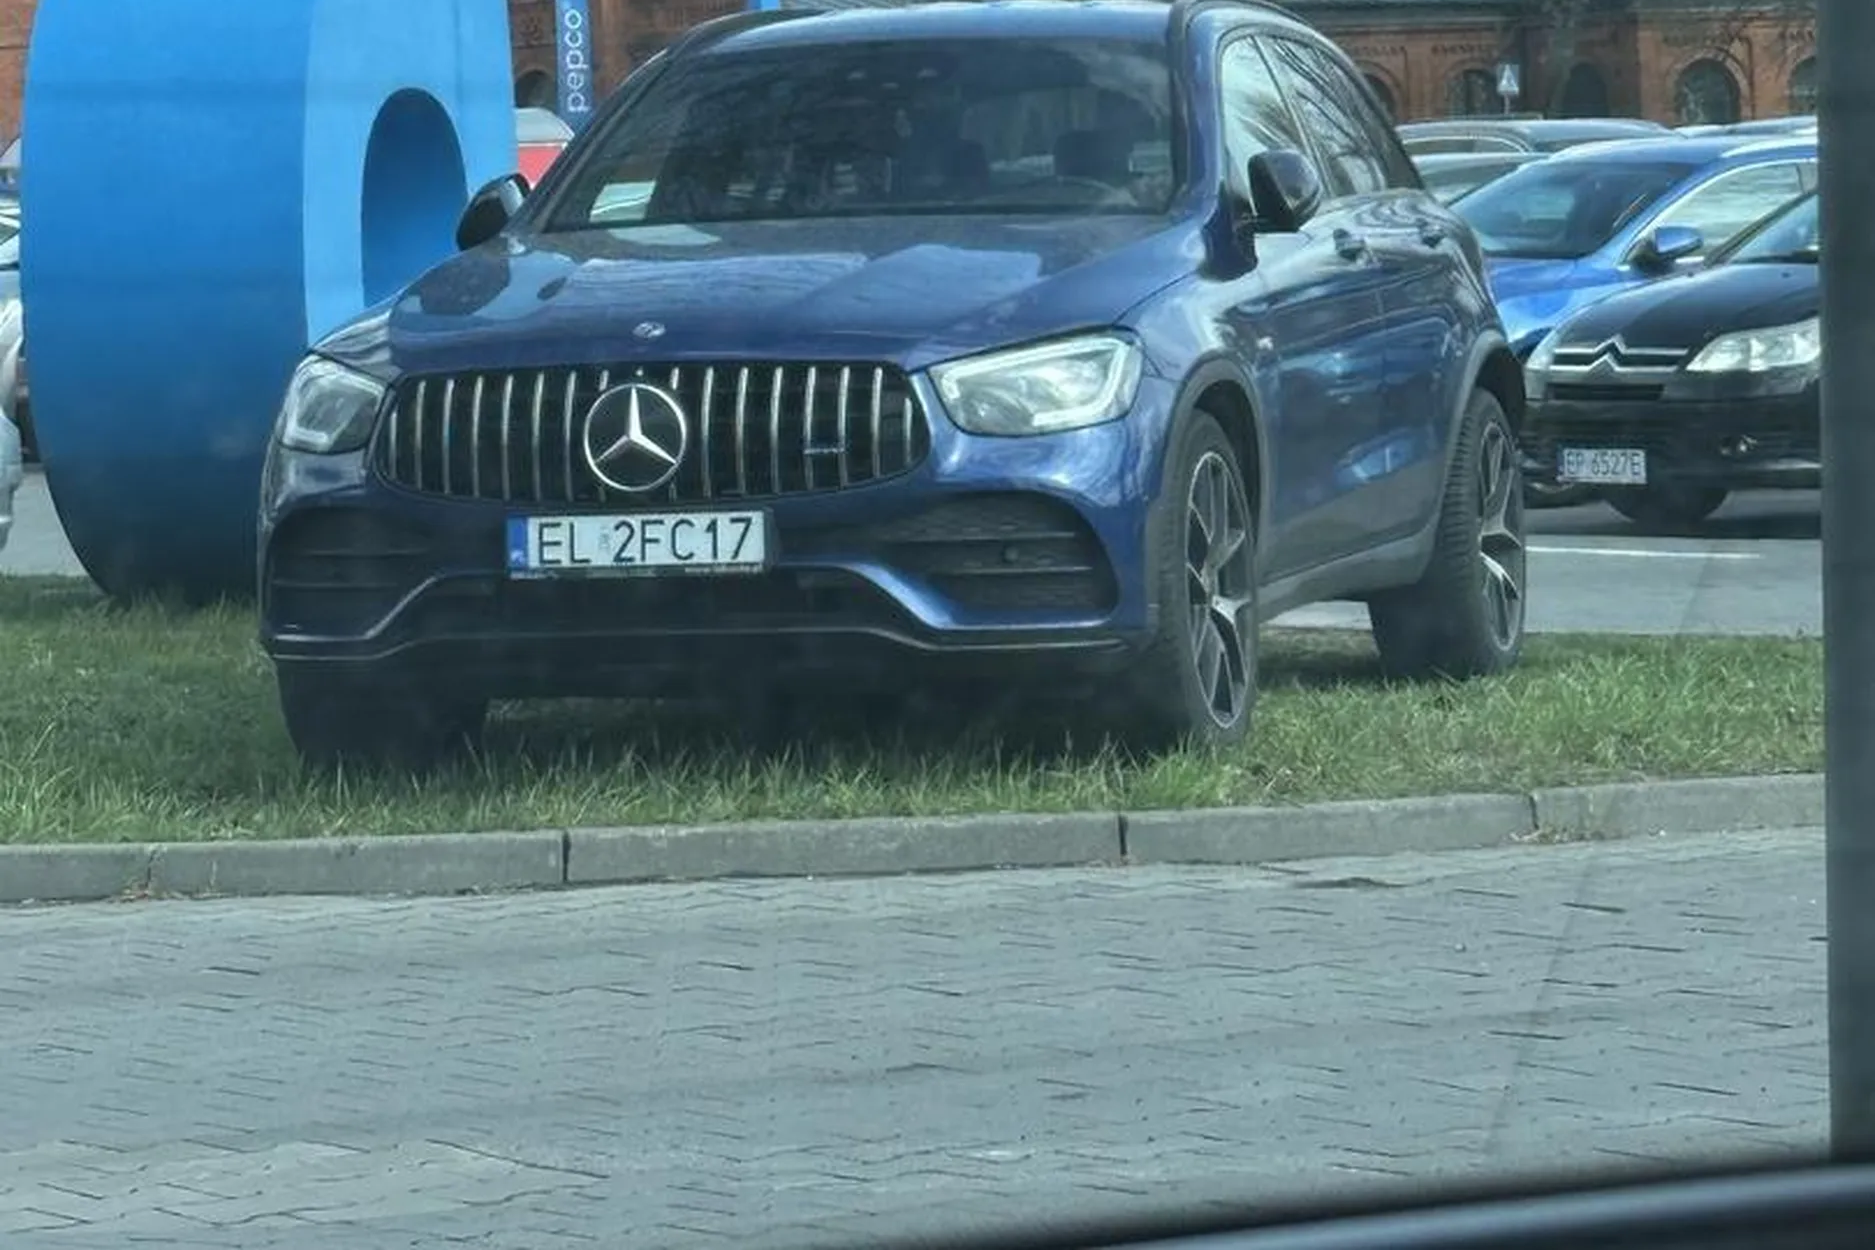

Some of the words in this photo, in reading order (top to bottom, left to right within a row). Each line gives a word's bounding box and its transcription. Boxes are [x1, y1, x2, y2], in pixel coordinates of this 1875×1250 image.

[564, 8, 590, 112] pepco
[537, 521, 591, 565] EL
[612, 516, 753, 563] 2FC17
